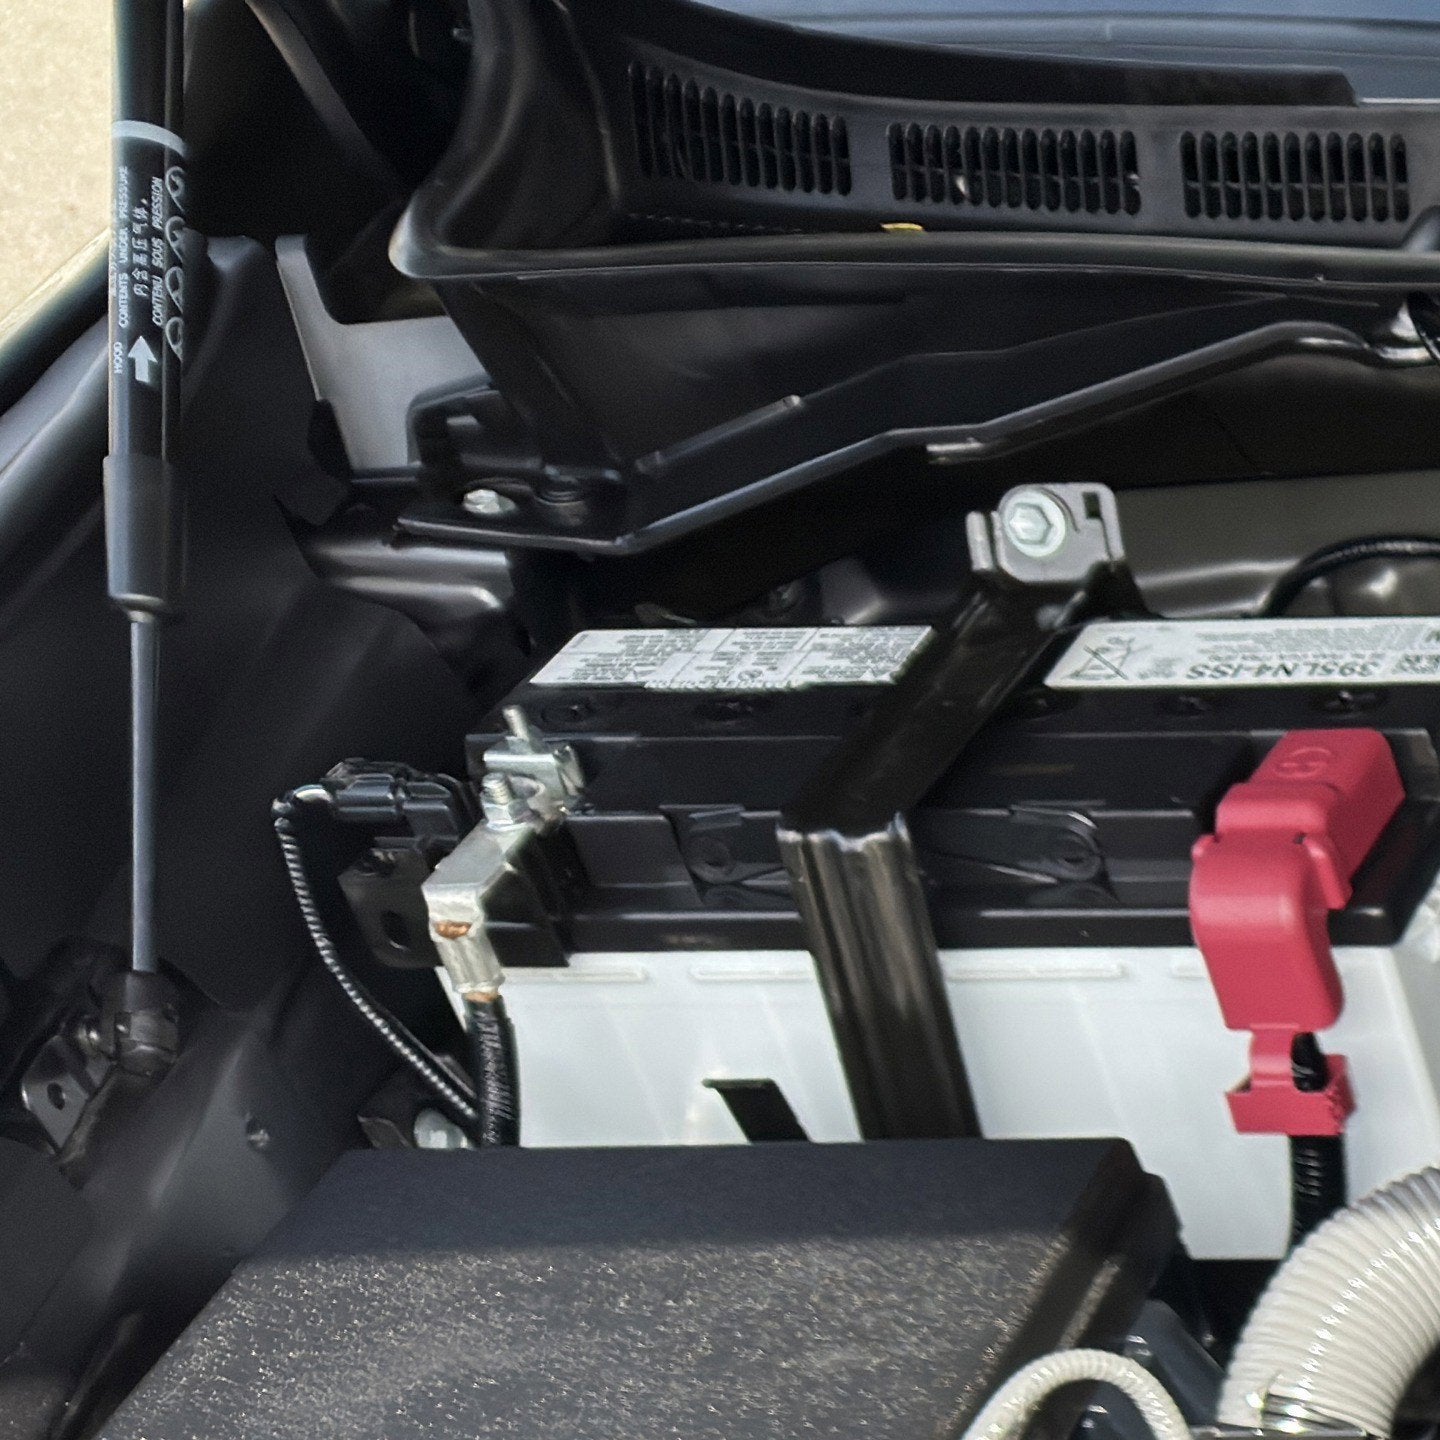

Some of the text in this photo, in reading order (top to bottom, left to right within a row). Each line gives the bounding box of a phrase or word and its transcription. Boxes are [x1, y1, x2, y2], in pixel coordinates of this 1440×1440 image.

[117, 165, 129, 329] CONTENTS UNDER PRESSURE
[151, 176, 164, 327] CONTENU SOUS PRESSION
[112, 341, 124, 374] HOOD
[1186, 661, 1382, 680] 395LN4-ISS
